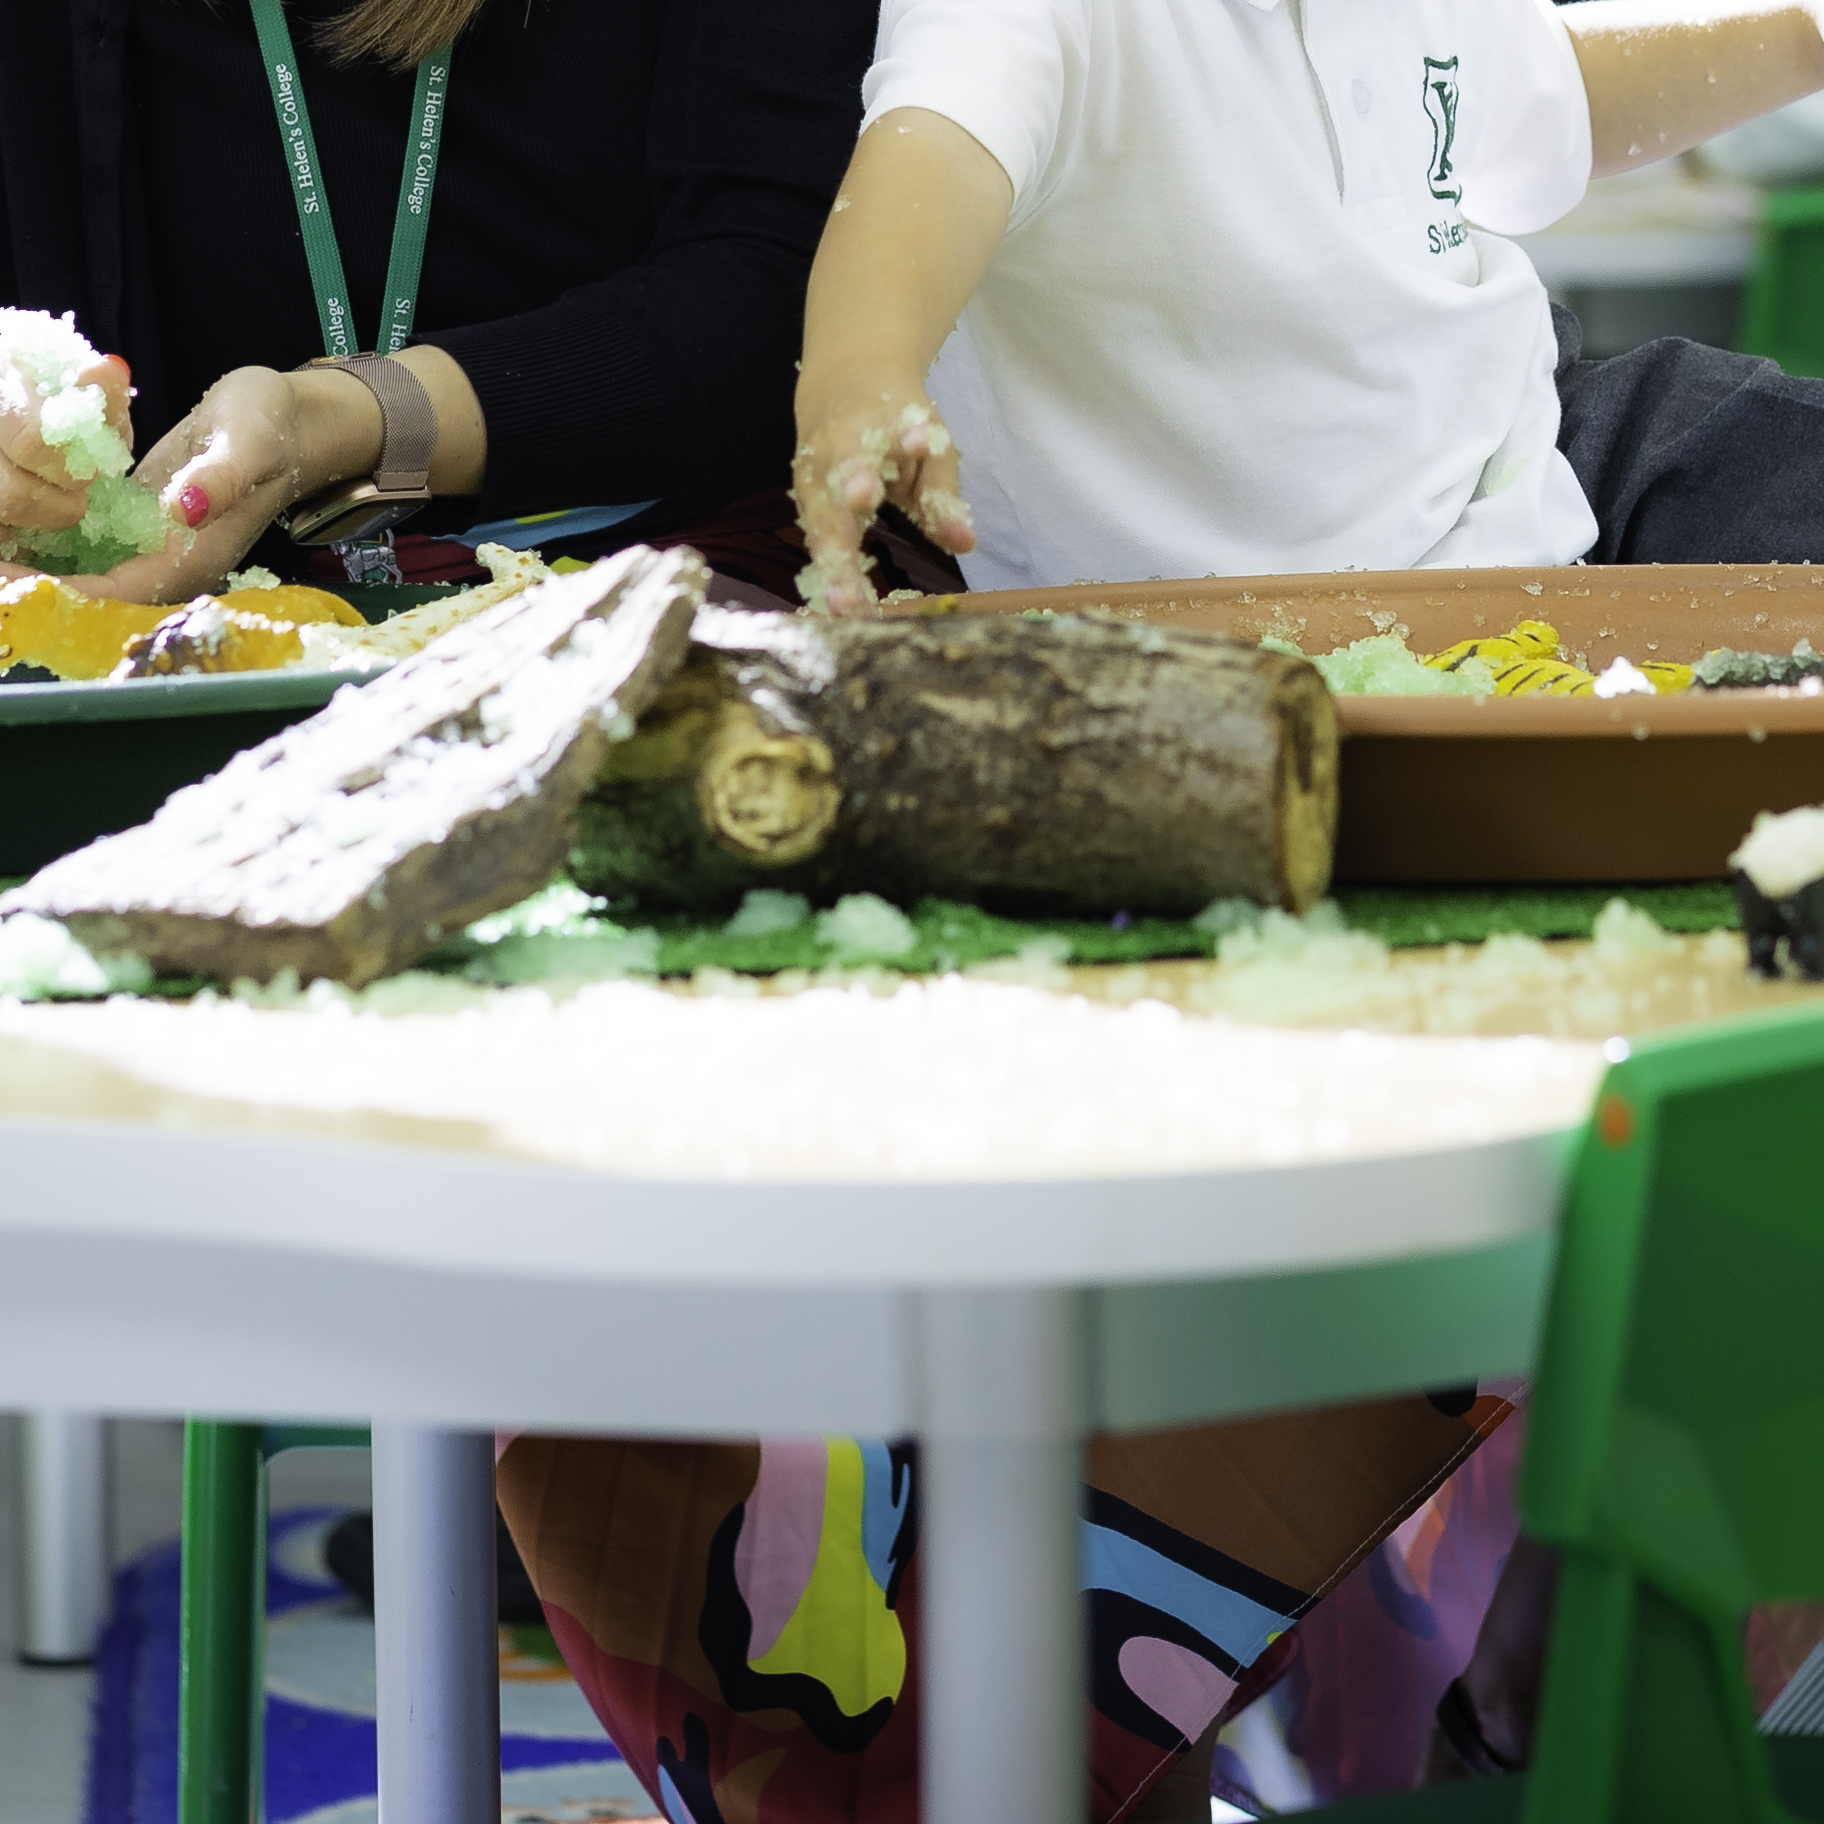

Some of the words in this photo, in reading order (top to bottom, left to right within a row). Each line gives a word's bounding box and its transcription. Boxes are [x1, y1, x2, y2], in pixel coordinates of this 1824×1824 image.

[275, 63, 299, 126] College
[428, 65, 446, 86] St.
[419, 90, 443, 150] Helen's
[288, 127, 314, 190] Helen's
[407, 153, 434, 215] College
[303, 191, 320, 215] St.
[327, 297, 349, 357] College
[393, 298, 411, 318] St.
